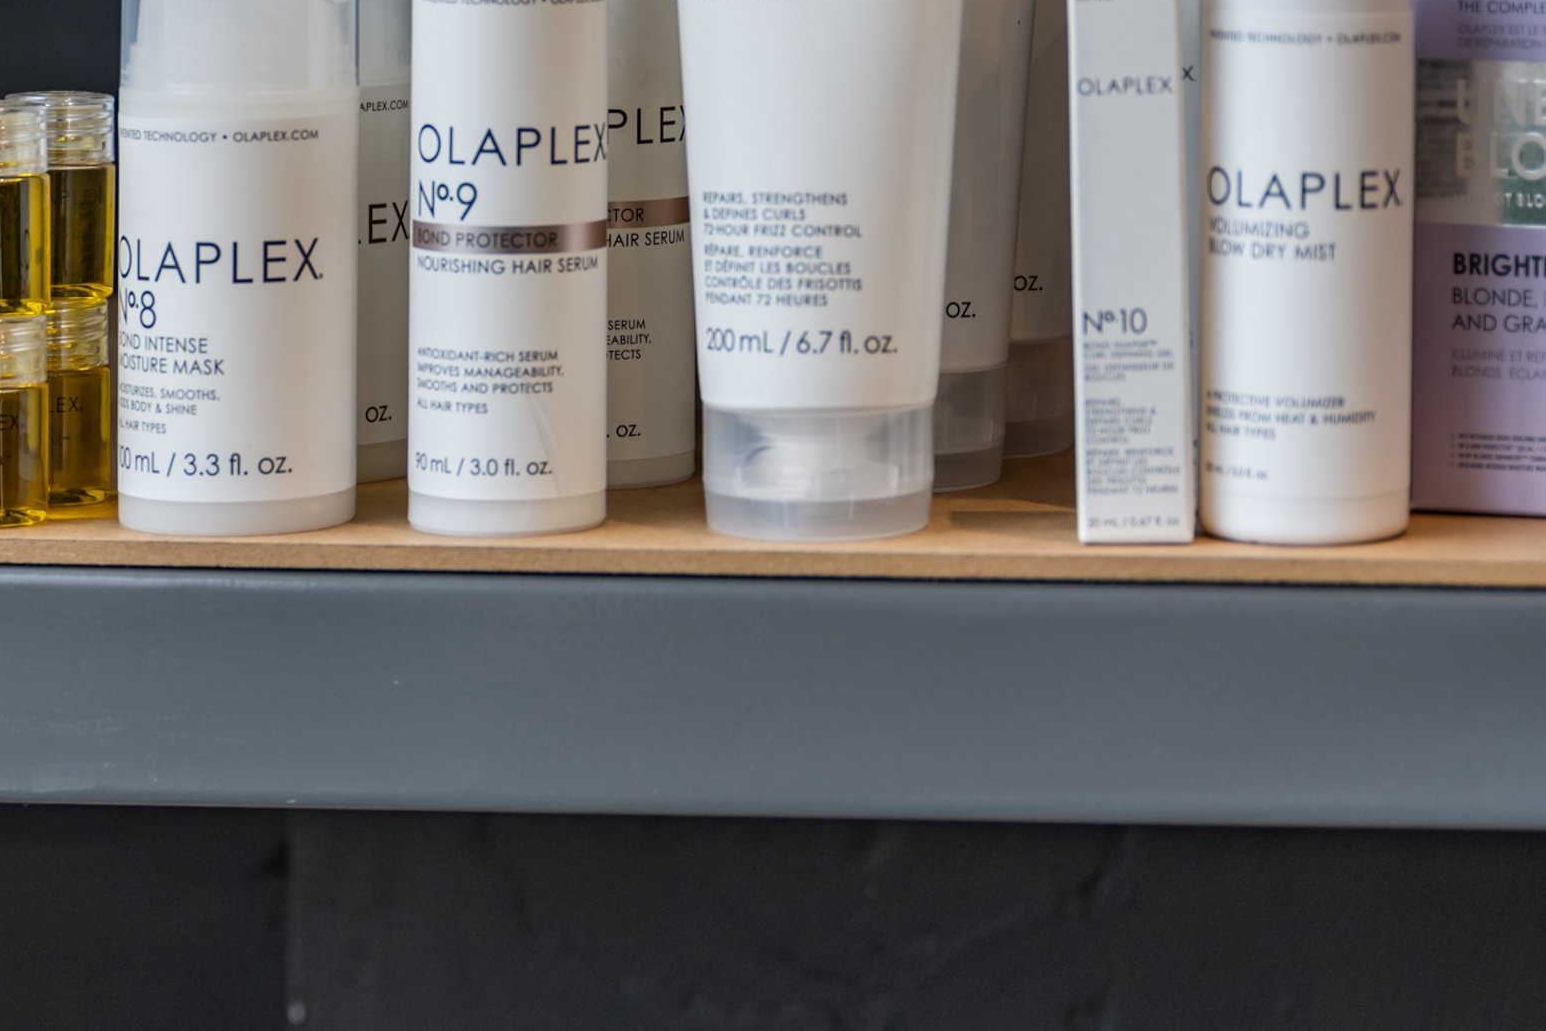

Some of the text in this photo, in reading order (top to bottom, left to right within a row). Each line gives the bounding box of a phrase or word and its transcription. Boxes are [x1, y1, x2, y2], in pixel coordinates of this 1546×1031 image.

[144, 129, 318, 143] TECHNOLOGY OLAPLEX.COM
[418, 124, 606, 166] OLAPLEX
[418, 229, 557, 249] BOND PROTECTOR
[644, 230, 684, 247] SERUM
[417, 255, 598, 275] NOURISHING HAIR SERUM
[1453, 253, 1546, 278] BRIGHT
[1451, 313, 1497, 332] AND
[145, 336, 208, 354] INTENSE
[706, 327, 735, 352] 200
[739, 331, 774, 354] mL
[796, 330, 833, 354] 6.7
[863, 335, 897, 354] oz.
[173, 359, 224, 375] MASK
[135, 451, 160, 474] mL
[166, 452, 176, 477] /
[184, 453, 220, 476] 3.3
[229, 453, 248, 476] fl.
[258, 456, 292, 475] oz.
[430, 457, 452, 474] mL
[470, 458, 499, 476] 3.0
[526, 461, 553, 476] oz.
